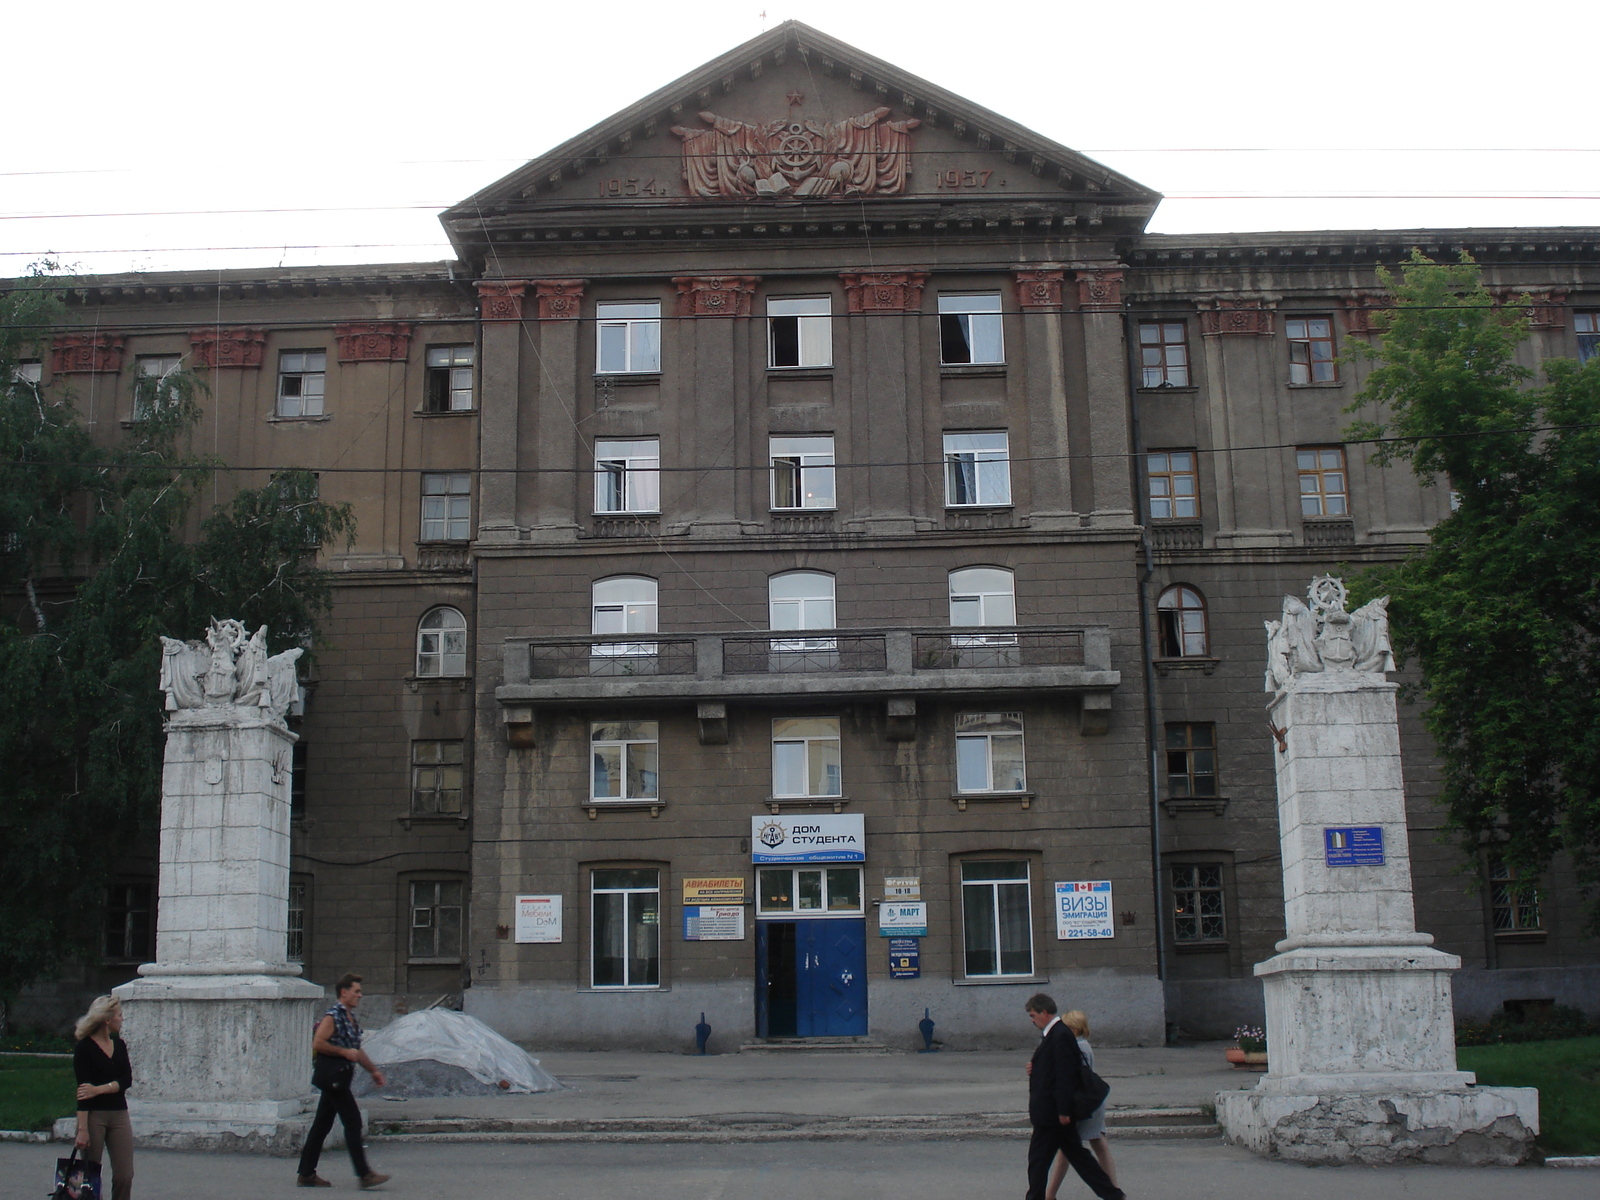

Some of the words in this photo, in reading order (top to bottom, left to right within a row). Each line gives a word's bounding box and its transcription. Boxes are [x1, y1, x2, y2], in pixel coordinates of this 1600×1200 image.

[792, 825, 821, 835] ДОМ
[792, 835, 857, 845] СТУДЕНТА
[685, 880, 743, 889] АВИАБИЛЕТЫ
[1061, 896, 1108, 911] ВИЗЫ
[521, 909, 552, 918] Мебели
[900, 908, 920, 916] МАРТ
[1062, 911, 1108, 919] ЭМИГРАЦИЯ
[1068, 928, 1112, 937] 221-58-40
